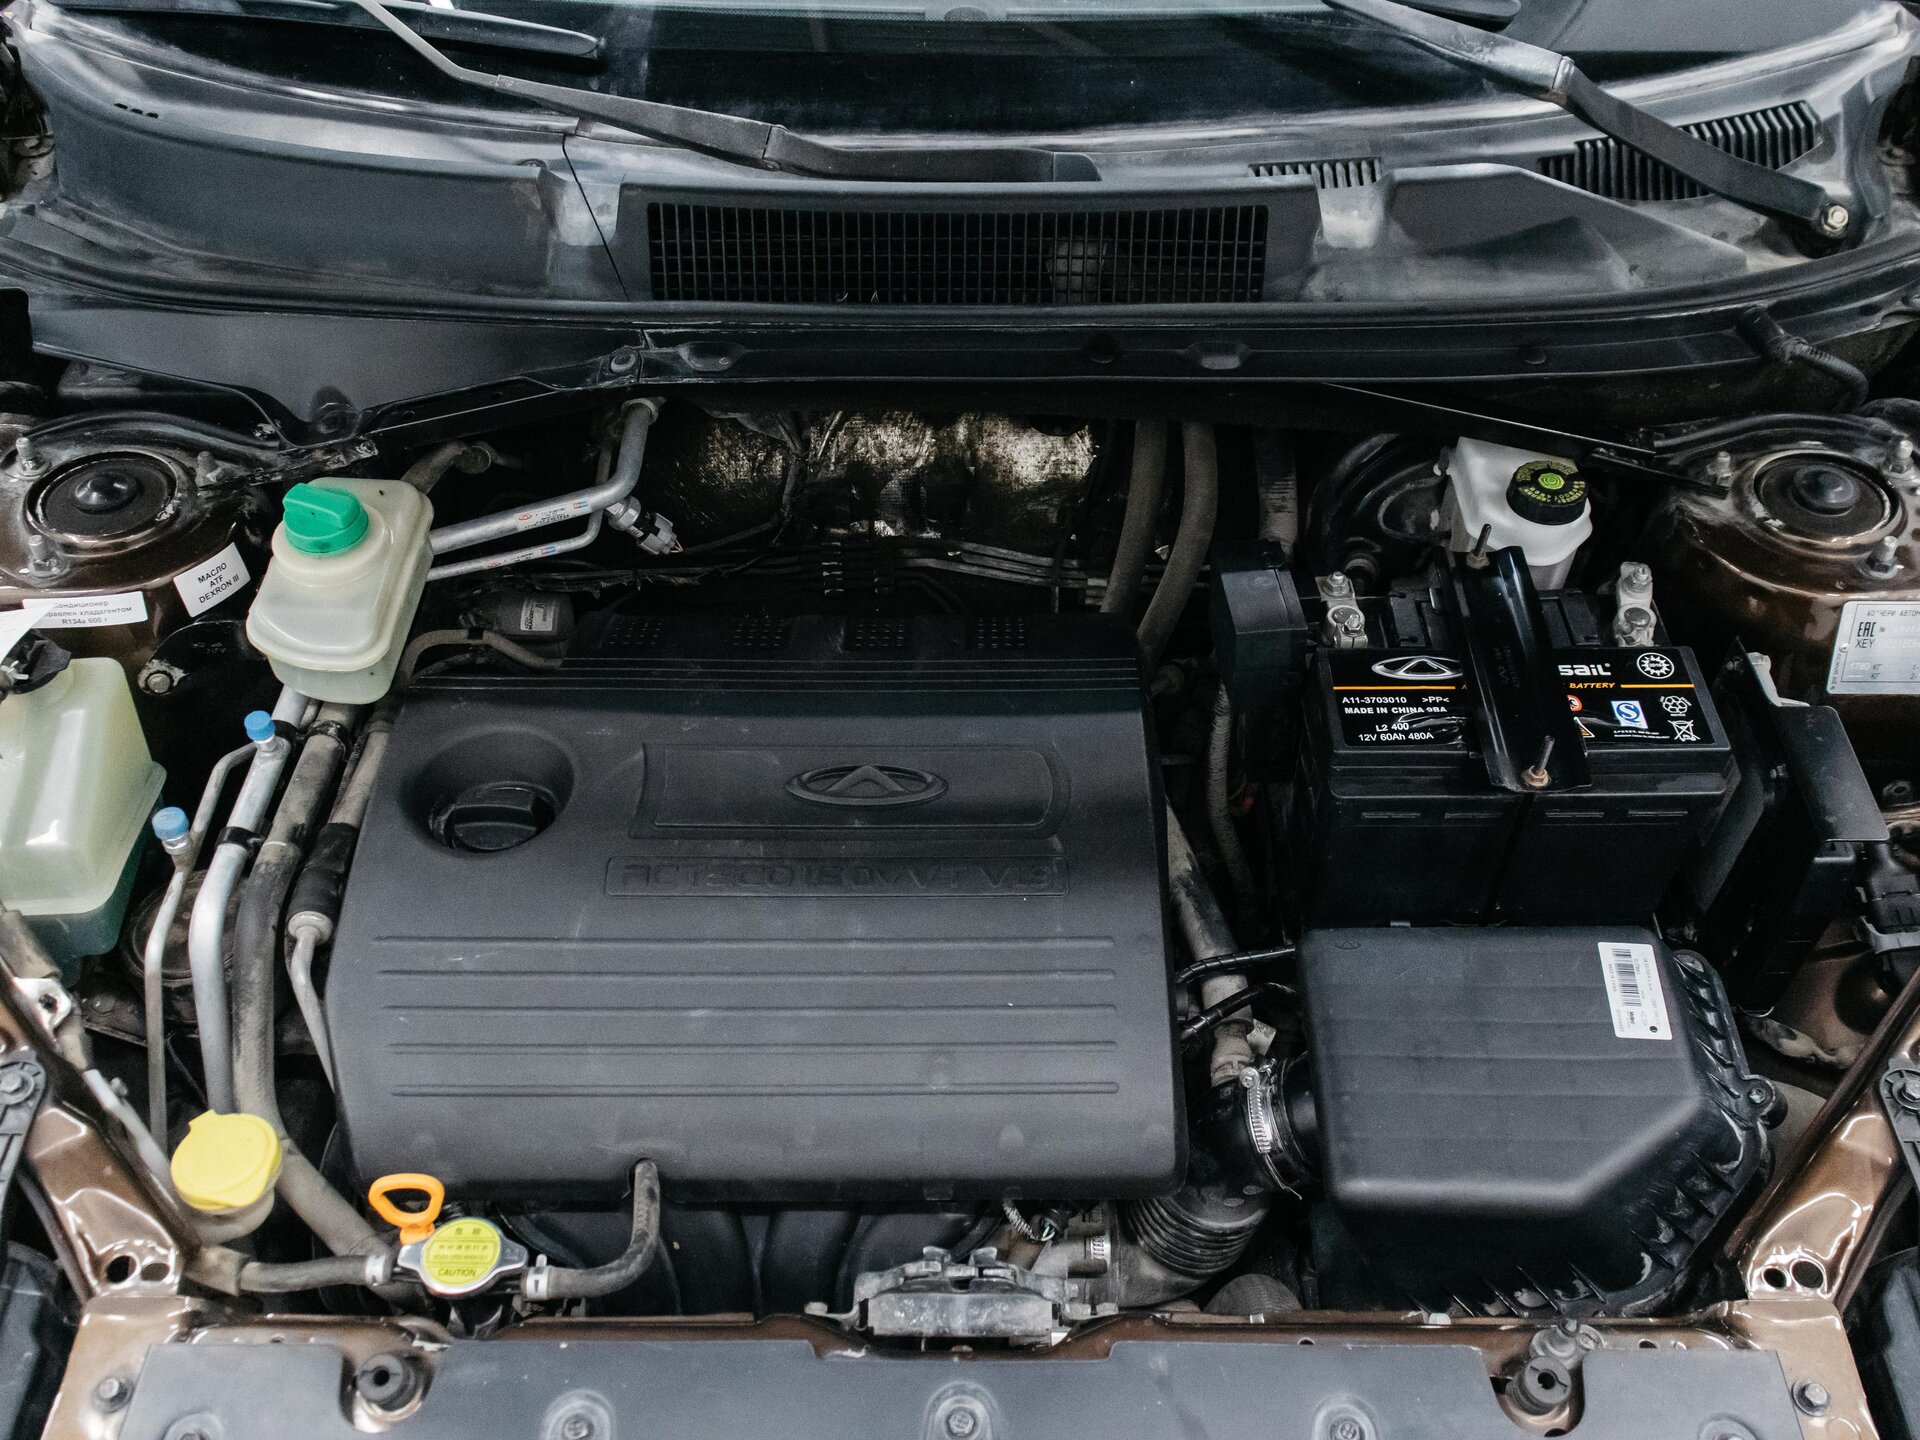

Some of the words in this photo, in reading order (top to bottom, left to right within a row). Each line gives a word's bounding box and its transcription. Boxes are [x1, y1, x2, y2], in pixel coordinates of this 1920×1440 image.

[197, 562, 227, 583] МАСЛО
[210, 574, 223, 587] ATF
[199, 579, 233, 603] DEXRON
[1857, 621, 1877, 637] EAC
[1341, 696, 1407, 704] A11-3703010
[1391, 706, 1425, 714] CHINA
[1375, 724, 1389, 732] L2
[1391, 722, 1410, 731] 400
[1358, 733, 1377, 742] 12V
[1379, 733, 1406, 741] 60Ah
[1408, 732, 1434, 740] 480A
[438, 1268, 476, 1278] CAUTION
